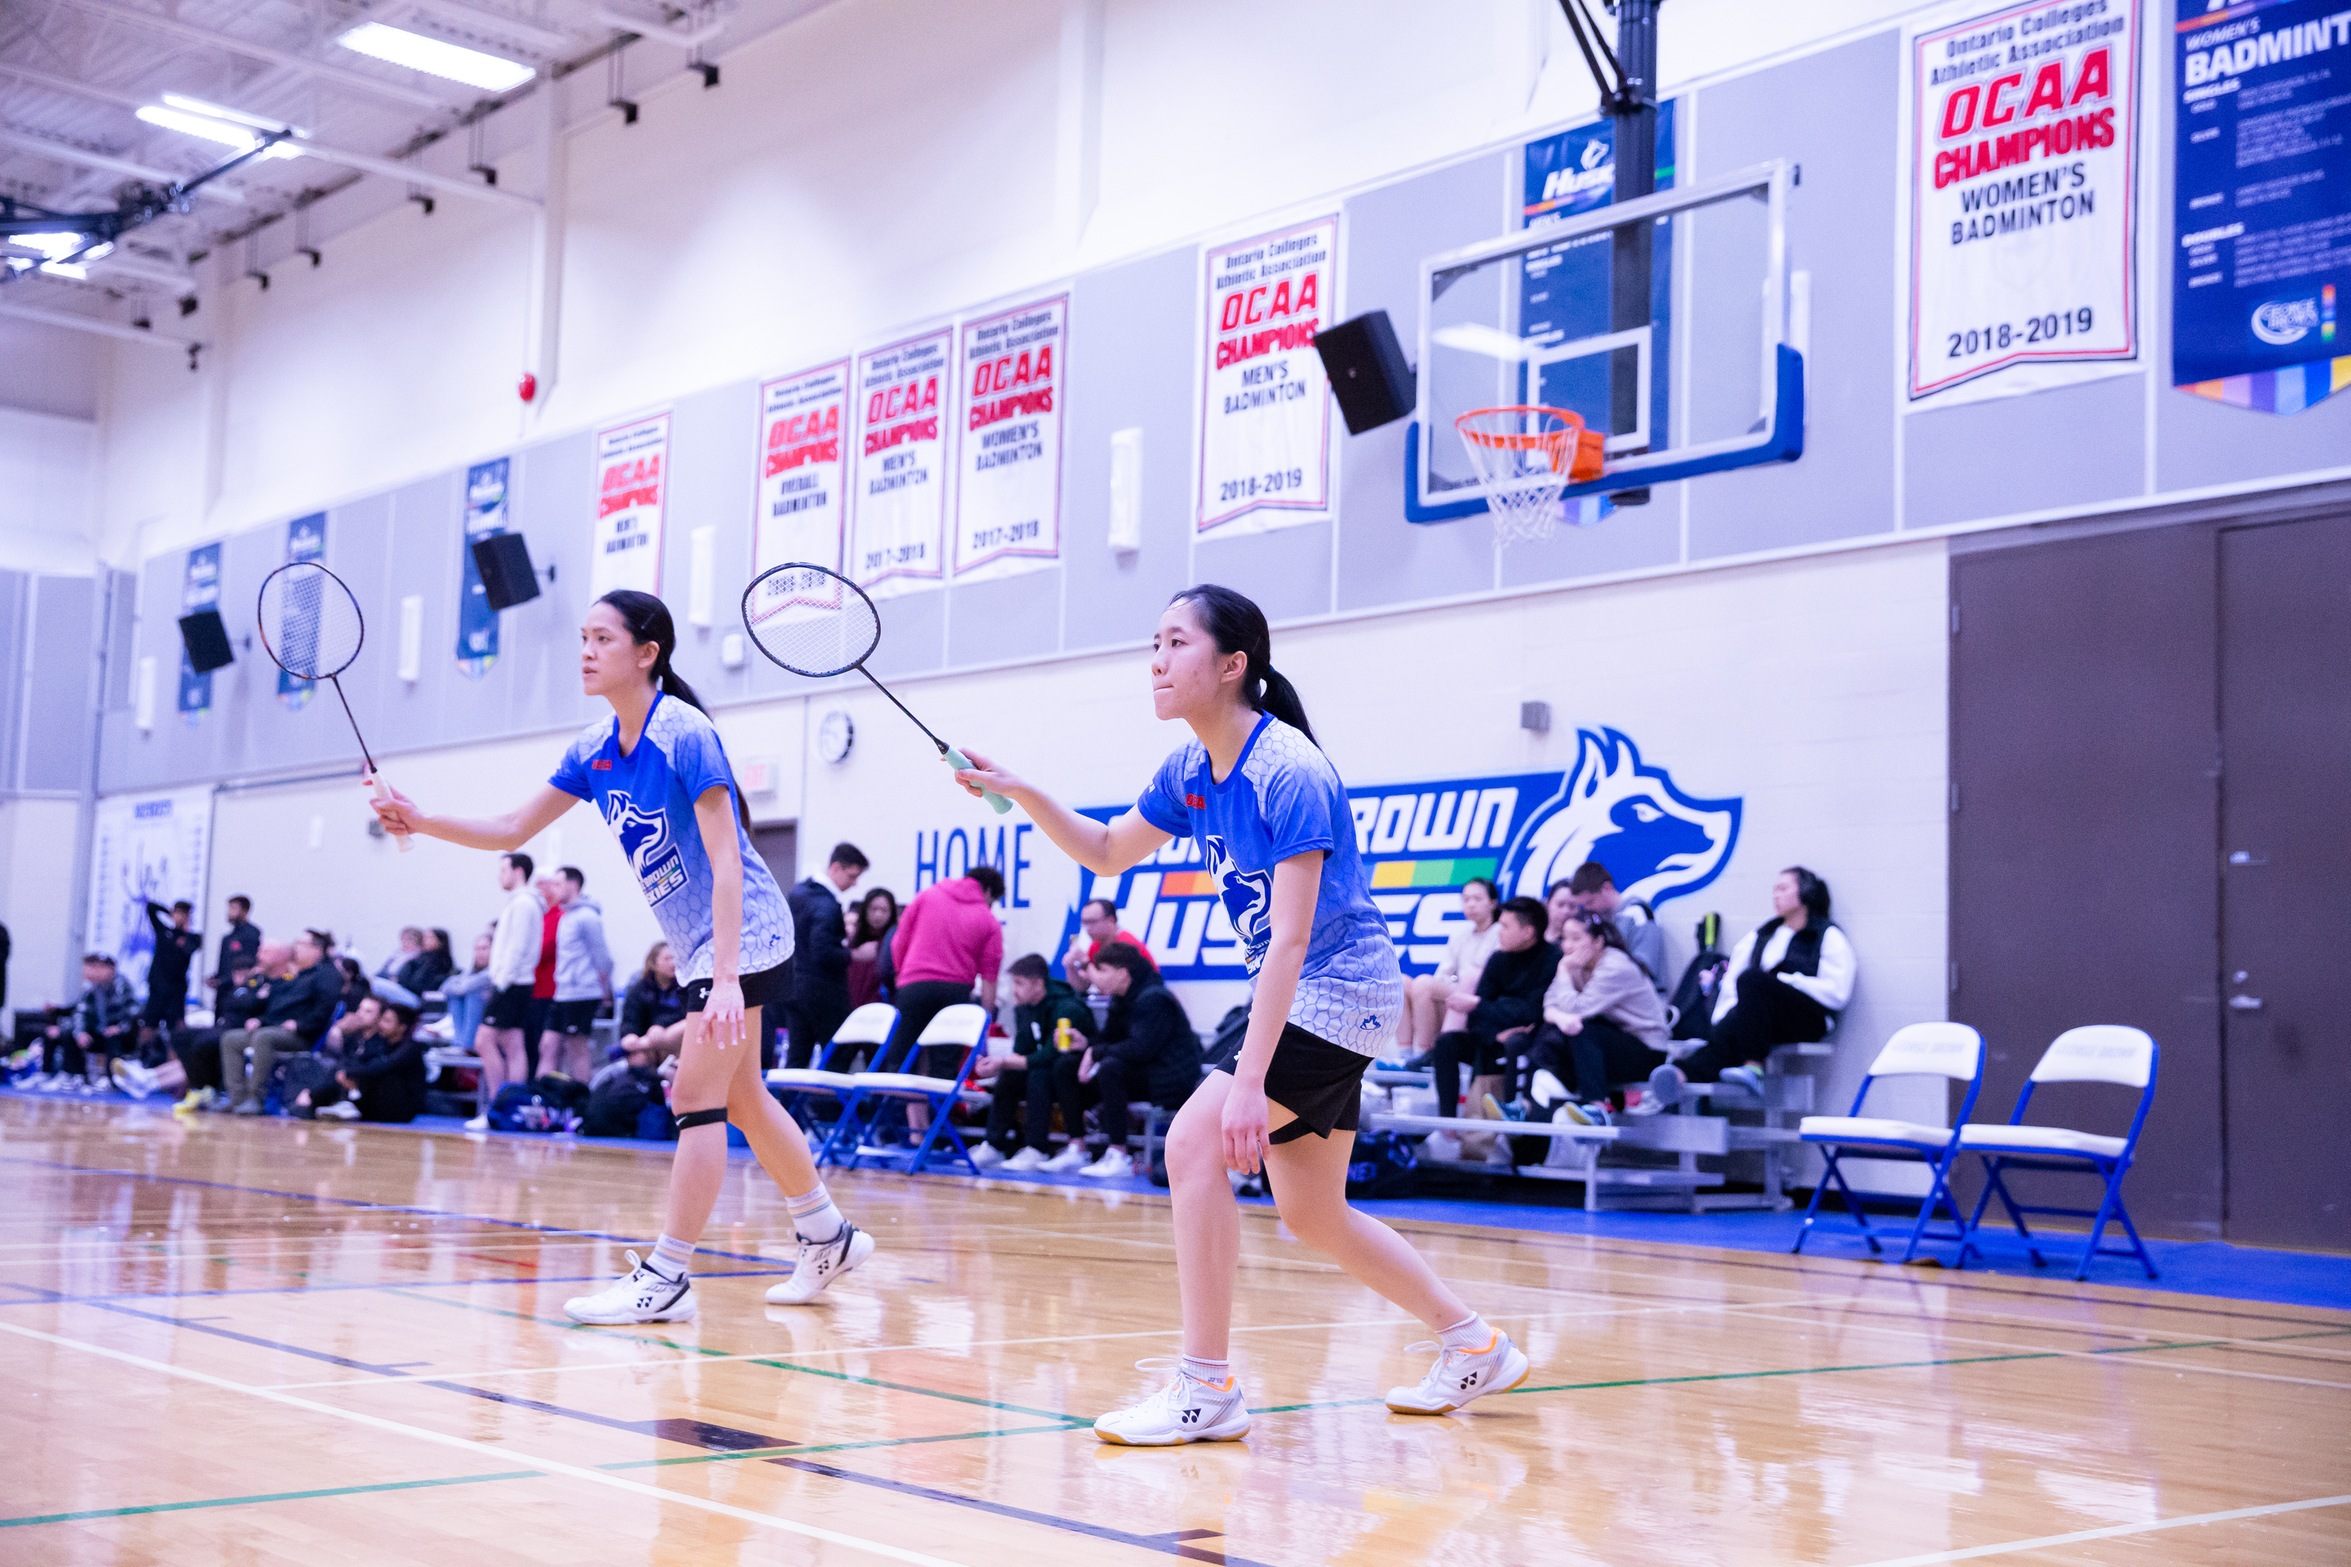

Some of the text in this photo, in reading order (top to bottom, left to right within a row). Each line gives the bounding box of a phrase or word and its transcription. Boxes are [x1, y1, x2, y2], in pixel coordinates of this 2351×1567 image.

[1931, 16, 2124, 86] Athletic Association
[1947, 0, 2108, 57] Ontario Colleges
[2185, 16, 2261, 51] WOMEN'S
[1940, 48, 2109, 139] OCAA
[1934, 106, 2115, 190] CHAMPIONS
[1961, 162, 2086, 213] WOMEN'S
[1952, 189, 2095, 245] BADMINTON
[1221, 273, 1317, 331] OCAA
[1216, 318, 1319, 370] CHAMPIONS
[1947, 306, 2093, 358] 2018-2019
[973, 345, 1051, 396] OCAA
[1242, 360, 1289, 387] MEN'S
[868, 377, 937, 424] OCAA
[1224, 380, 1306, 414] BADMINTON
[768, 405, 839, 449] OCAA
[602, 454, 660, 491] OCAA
[1220, 469, 1302, 501] 2018-2019
[1350, 787, 1519, 855] ROWN
[916, 823, 1032, 908] HOME
